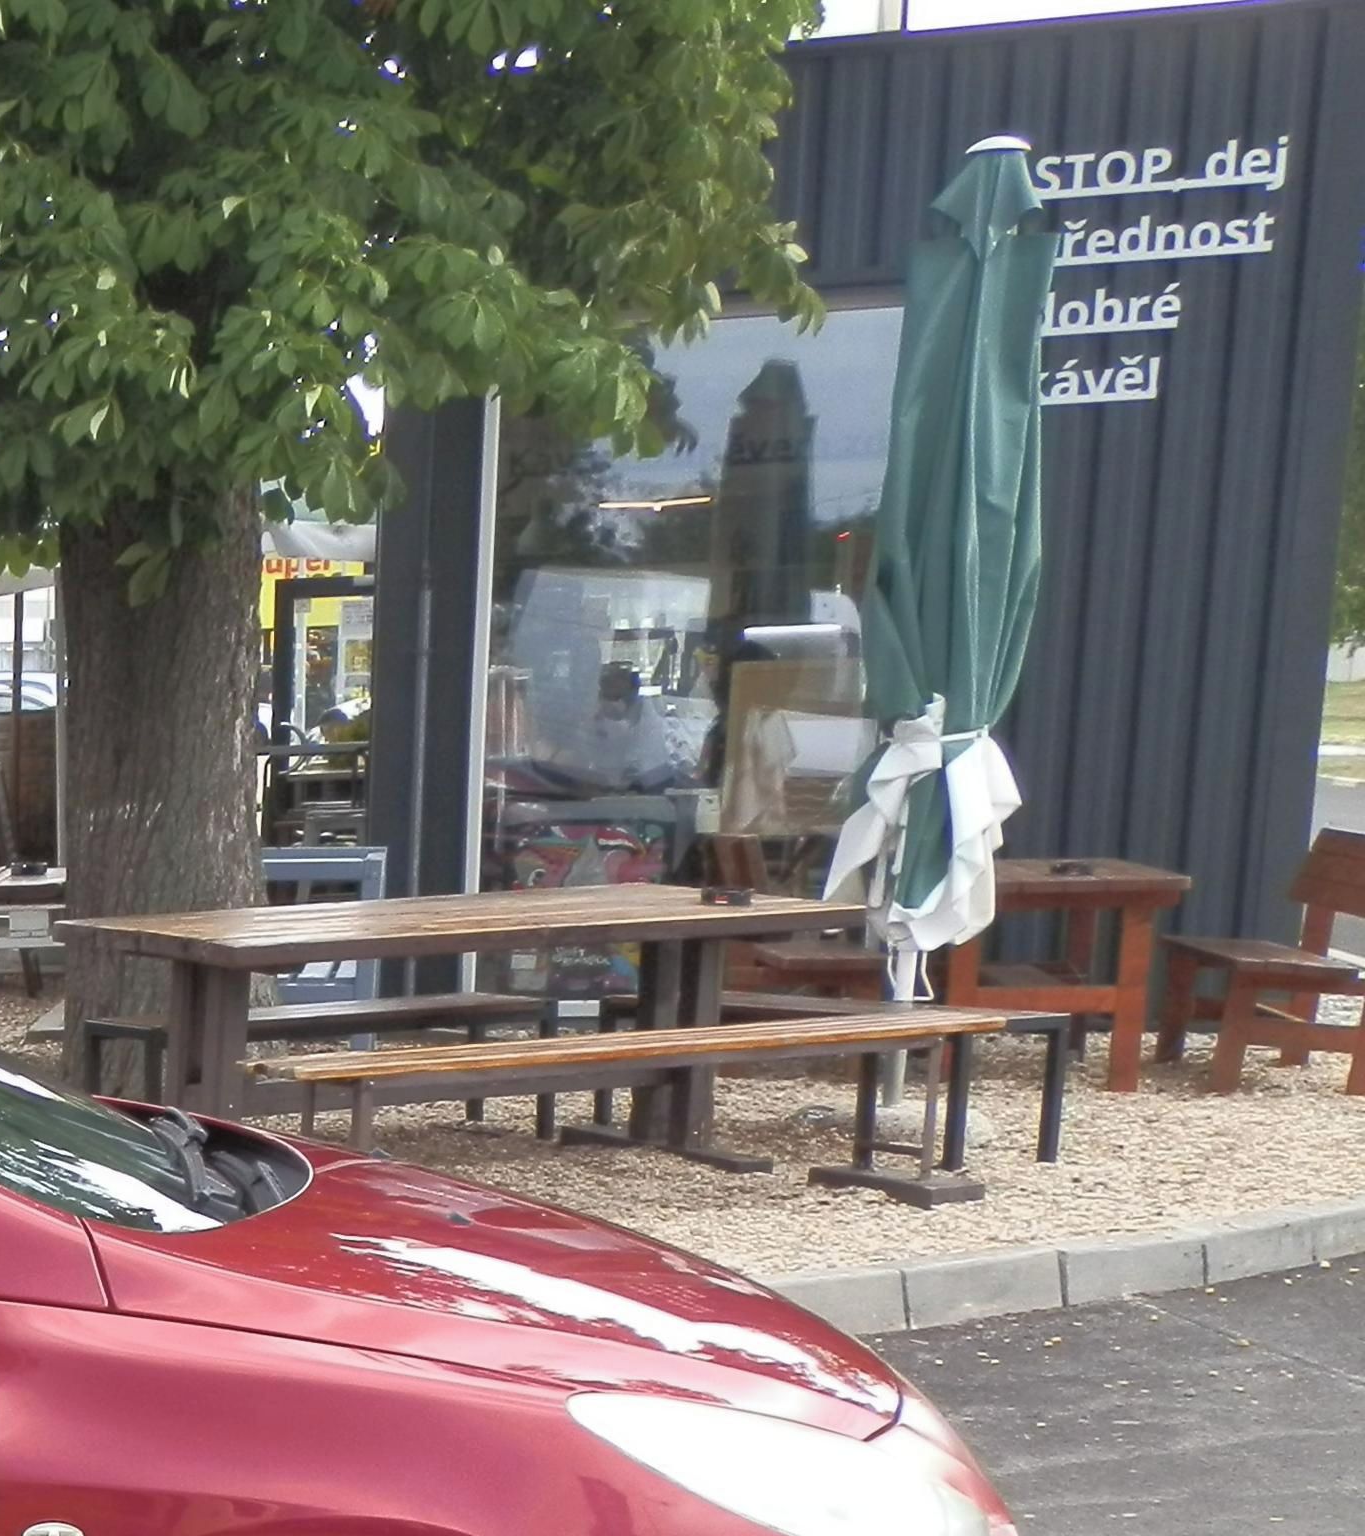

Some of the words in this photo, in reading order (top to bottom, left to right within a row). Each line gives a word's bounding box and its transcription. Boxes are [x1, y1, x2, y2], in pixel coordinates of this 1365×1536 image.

[1205, 135, 1289, 191] dej
[1055, 211, 1275, 262] řednost
[263, 557, 332, 580] uper
